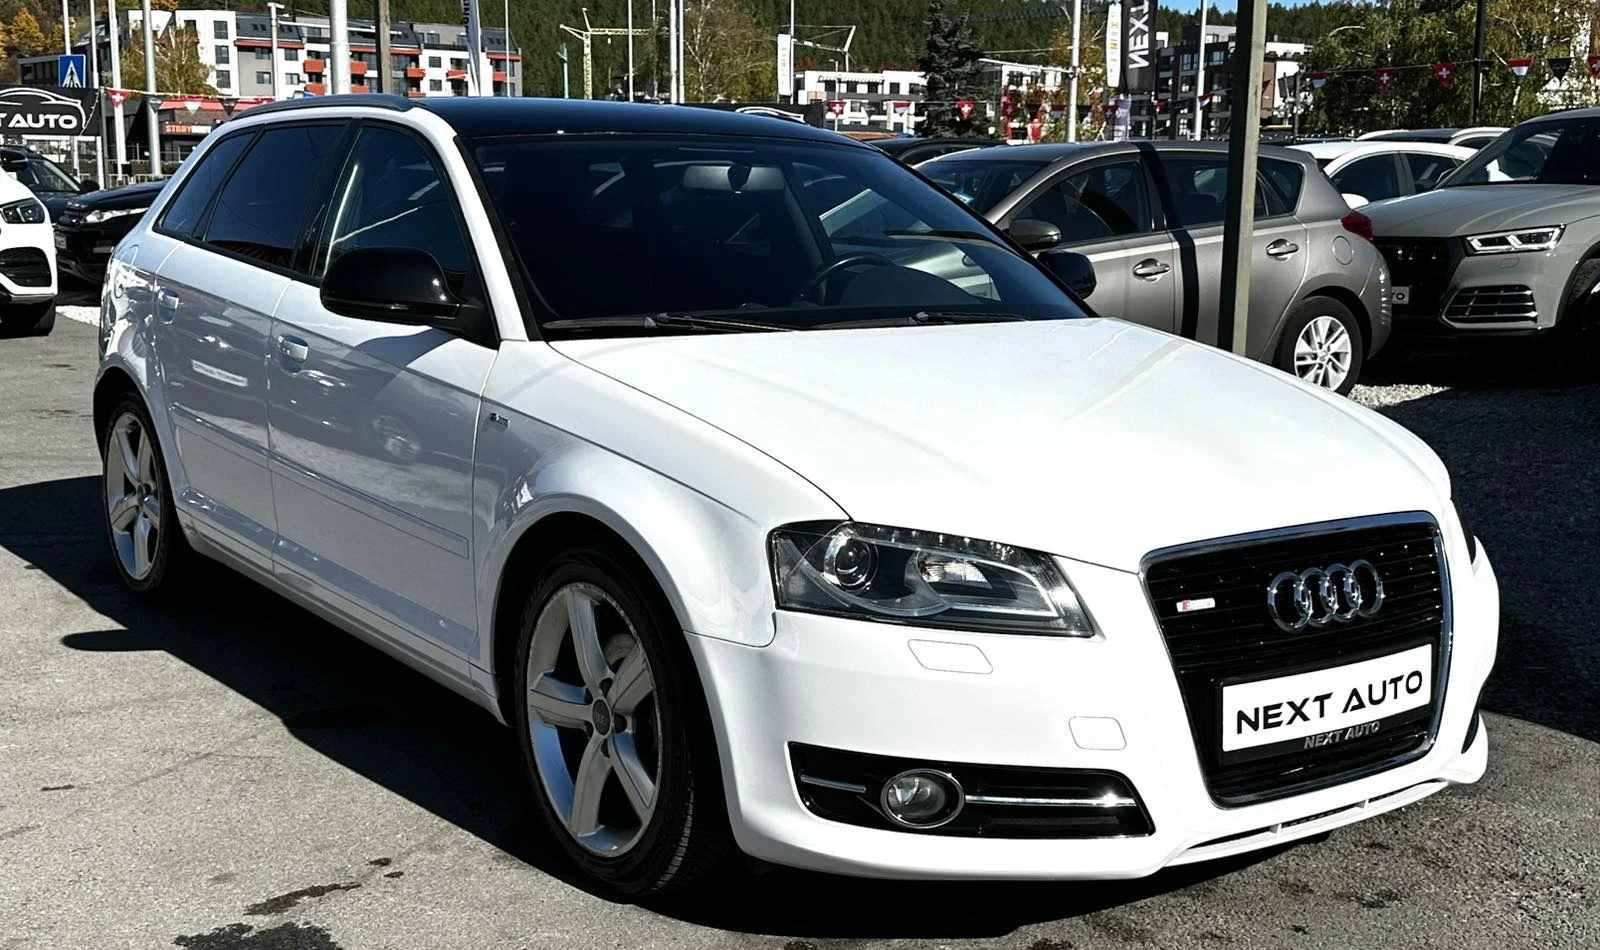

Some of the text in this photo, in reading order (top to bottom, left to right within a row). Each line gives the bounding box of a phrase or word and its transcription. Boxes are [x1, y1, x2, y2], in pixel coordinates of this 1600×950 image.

[8, 113, 78, 129] AUTO
[1236, 670, 1423, 735] NEXT AUTO
[1303, 720, 1381, 750] NEXT AUTO
